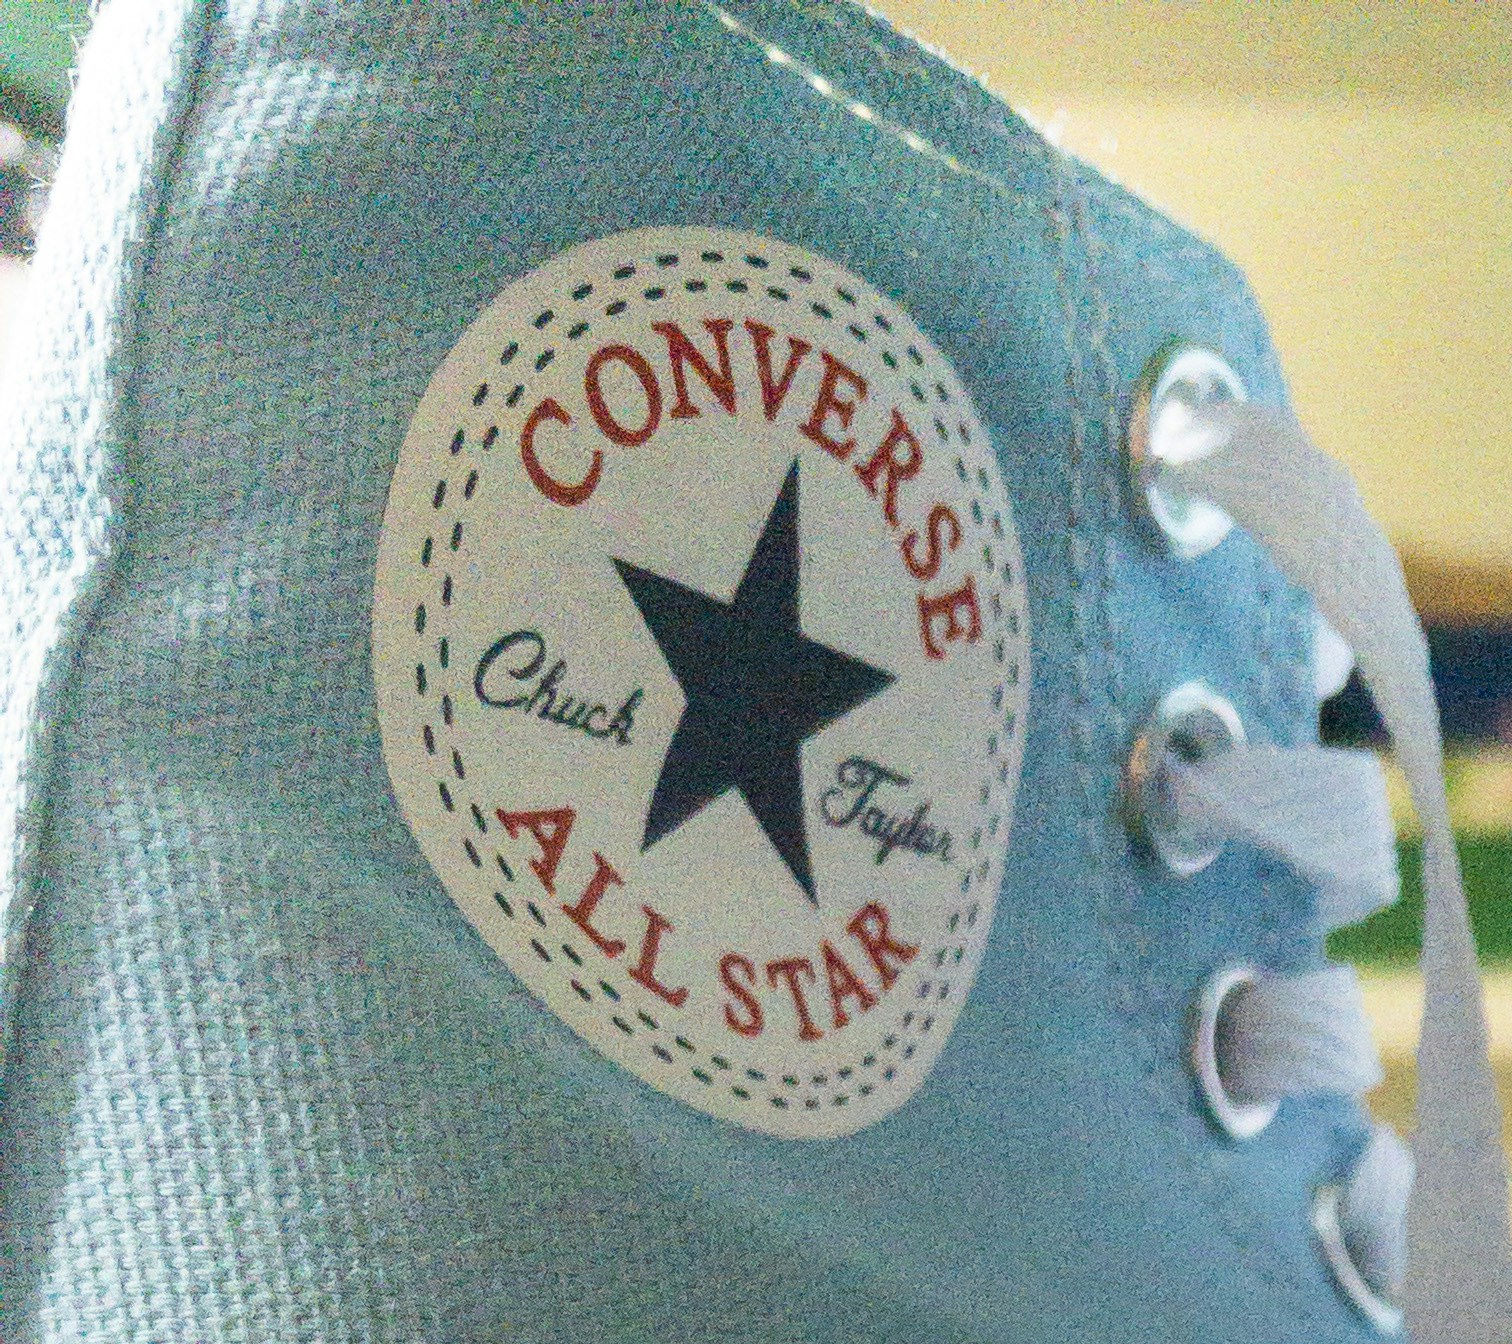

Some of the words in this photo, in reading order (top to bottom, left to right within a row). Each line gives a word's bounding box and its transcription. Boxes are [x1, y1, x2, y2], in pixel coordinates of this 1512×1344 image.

[519, 318, 983, 660] CONVERSE
[472, 629, 642, 747] Chuck
[820, 755, 953, 866] Taylor
[497, 804, 688, 1006] ALL
[719, 900, 920, 1041] STAR
